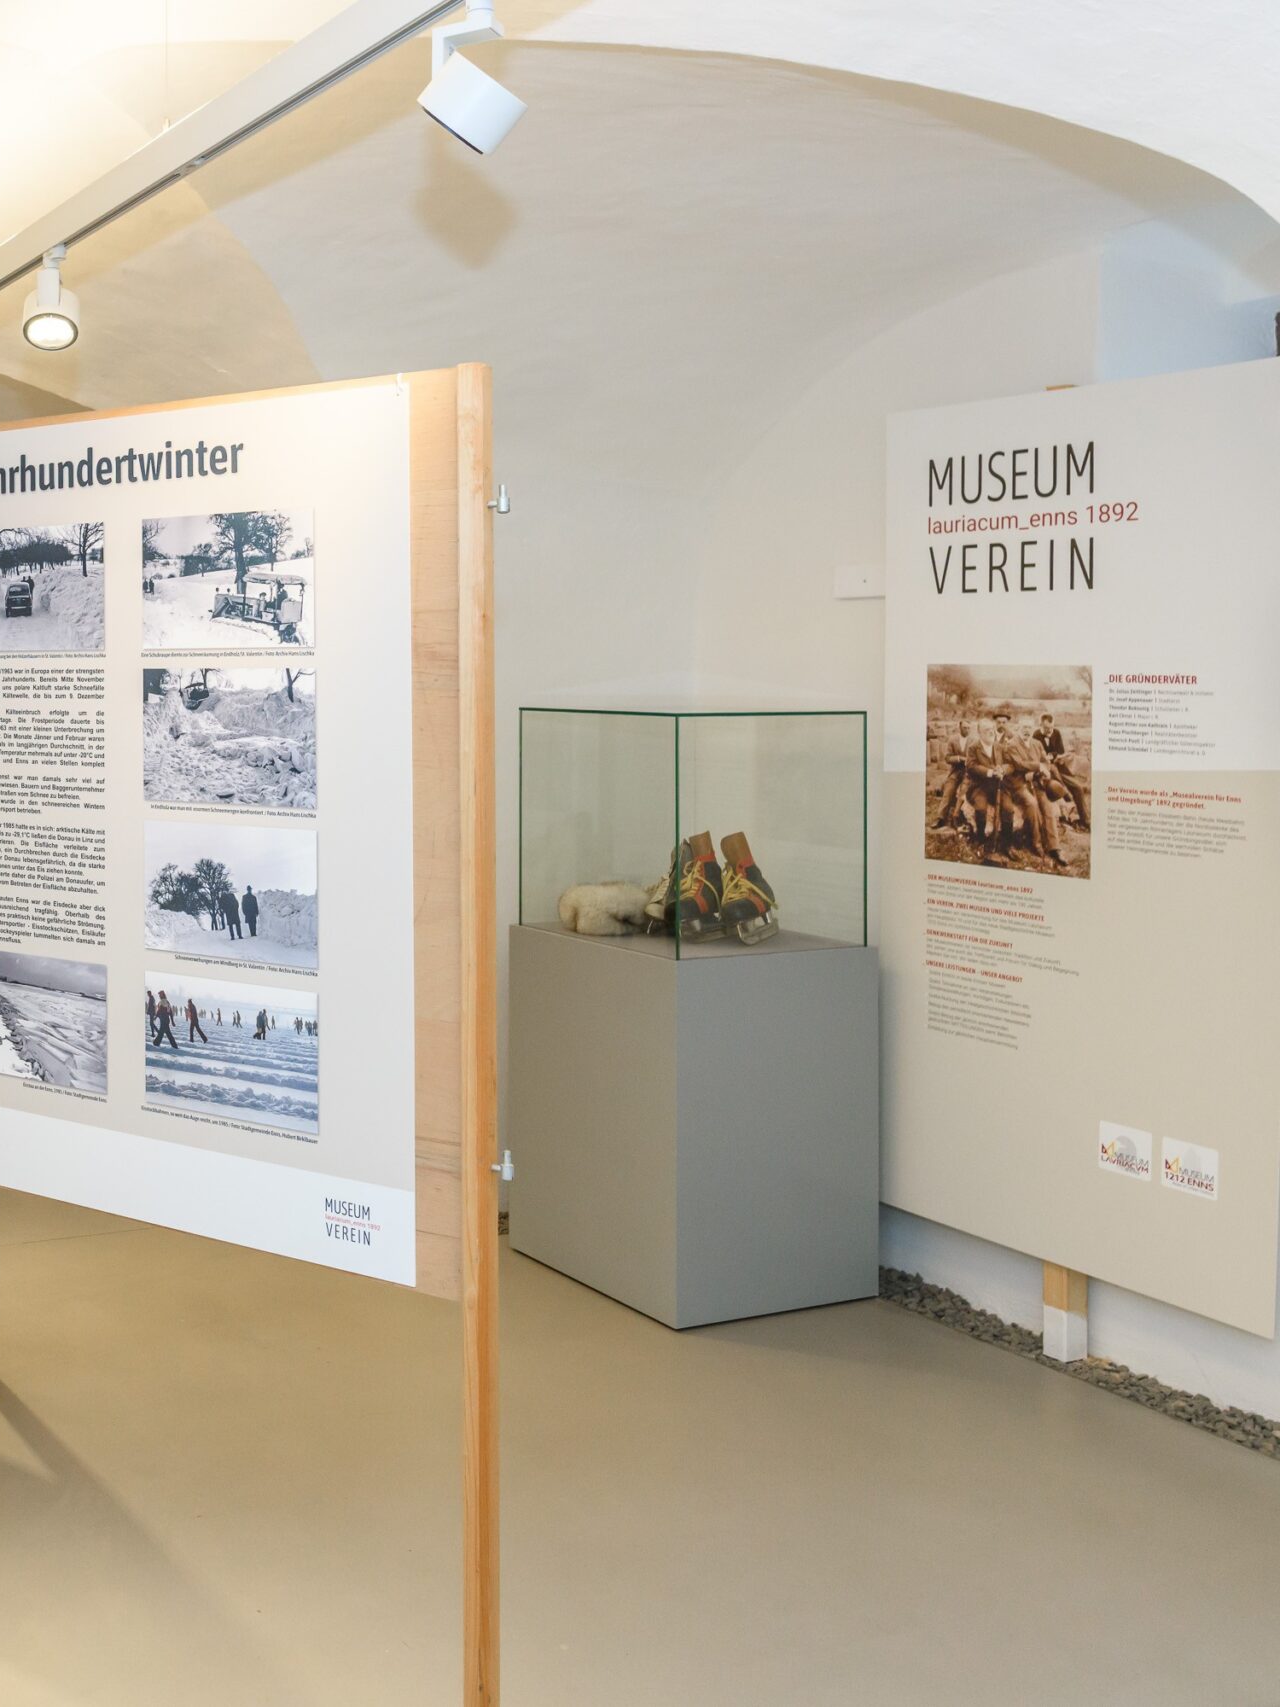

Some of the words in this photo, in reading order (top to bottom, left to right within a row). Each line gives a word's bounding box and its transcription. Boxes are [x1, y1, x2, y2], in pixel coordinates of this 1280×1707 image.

[928, 441, 1095, 507] MUSEUM
[927, 509, 1078, 535] lauriacum_enns
[1086, 501, 1139, 525] 1892
[928, 537, 1095, 595] VEREIN
[1125, 674, 1197, 685] GRÜNDERVÄTER
[1164, 1171, 1185, 1184] 1212
[1187, 1178, 1214, 1192] ENNS
[325, 1197, 370, 1221] MUSEUM
[325, 1221, 371, 1247] VEREIN
